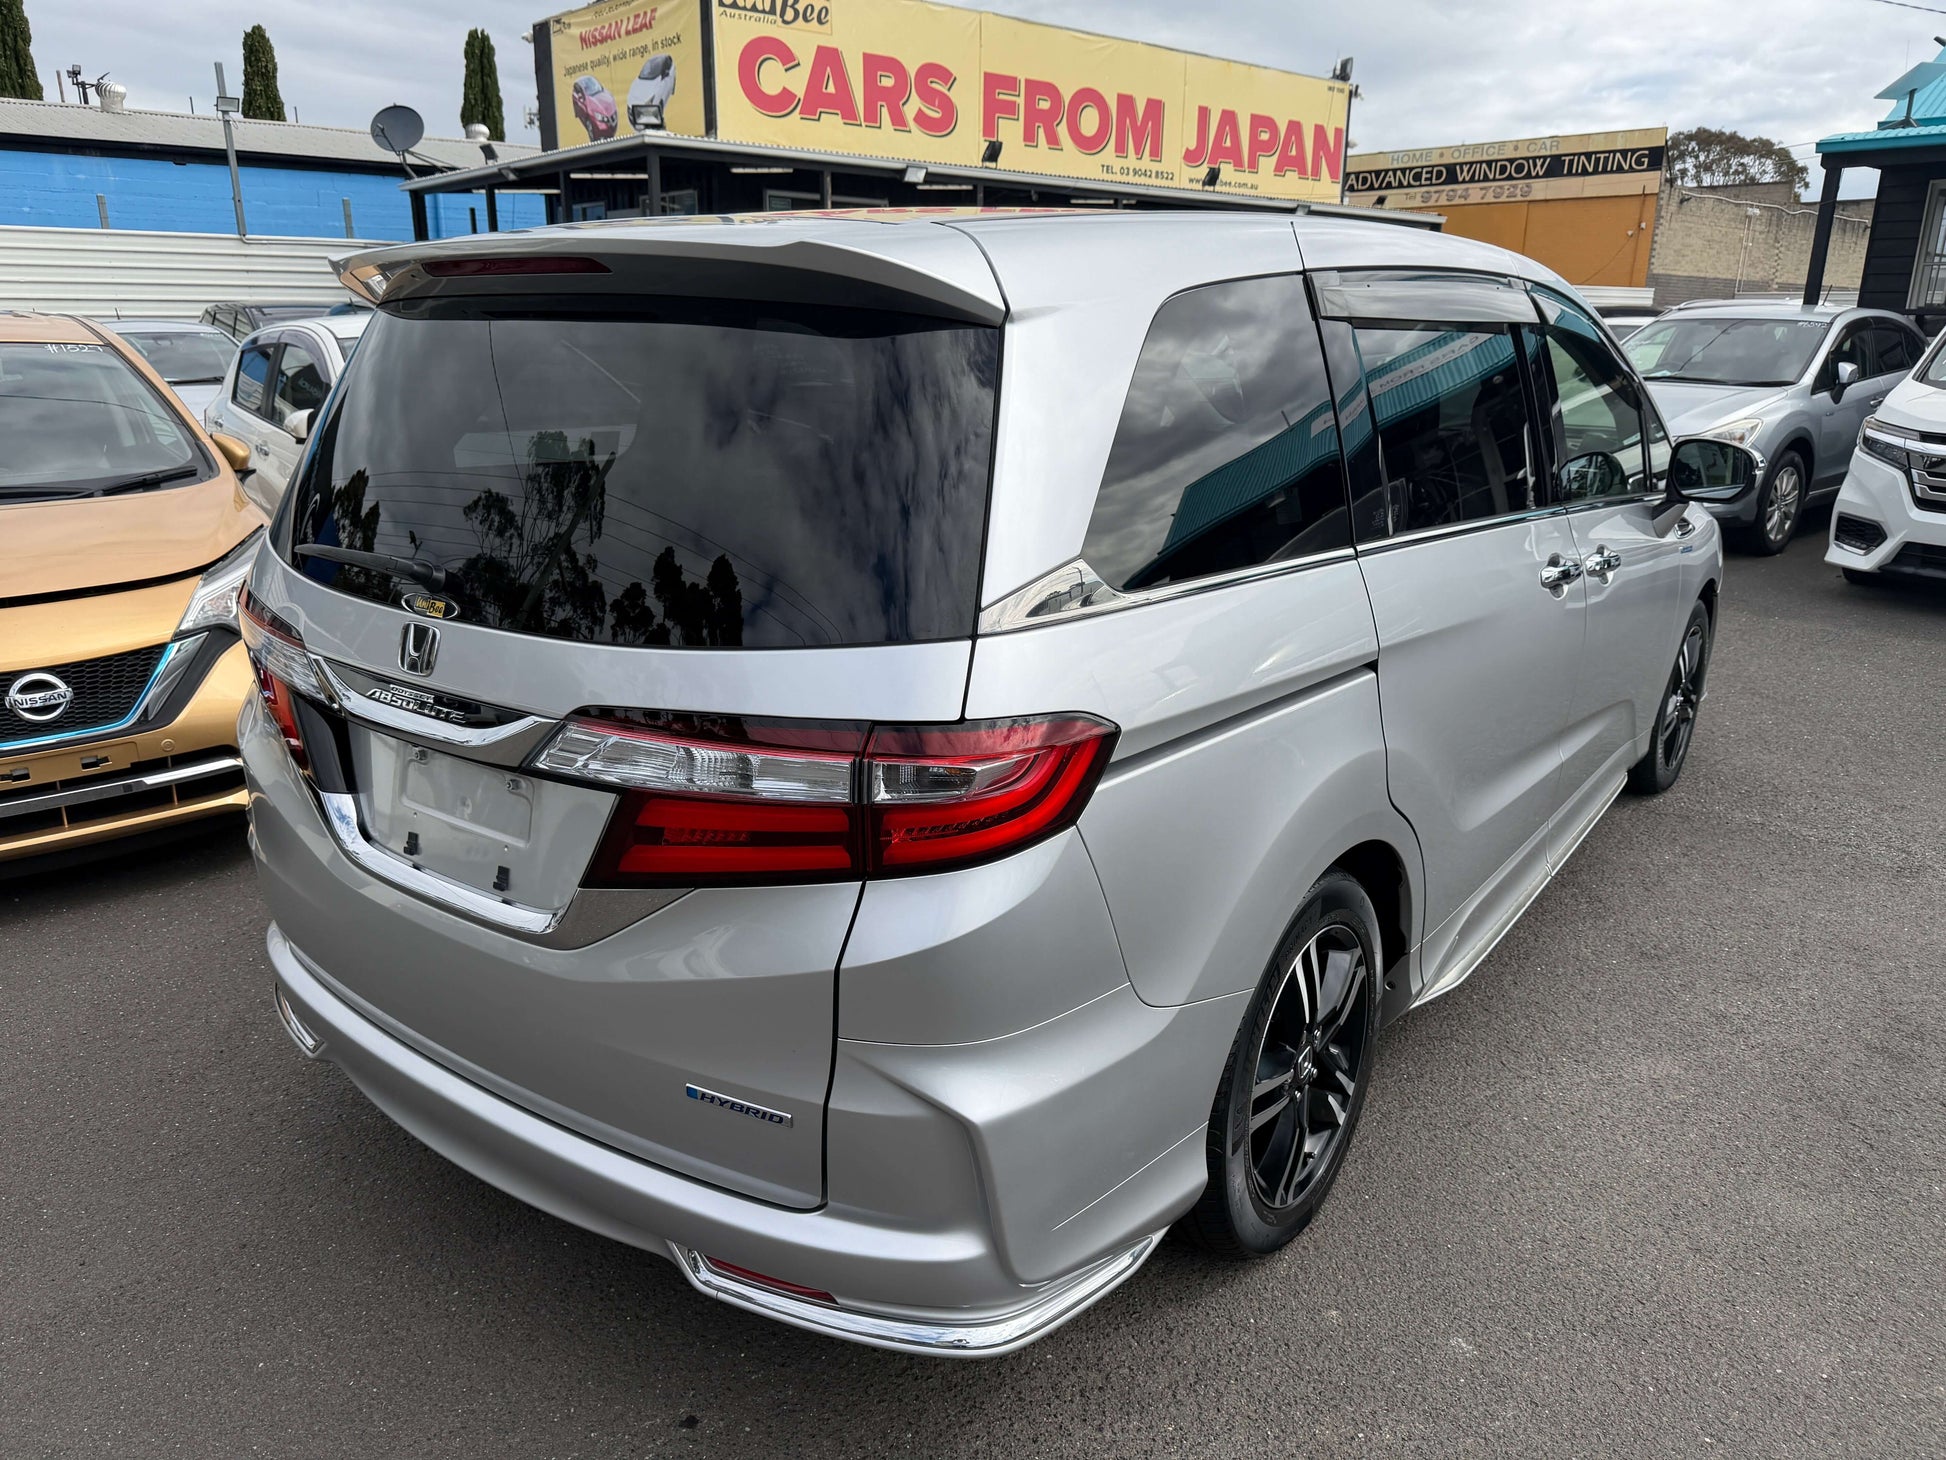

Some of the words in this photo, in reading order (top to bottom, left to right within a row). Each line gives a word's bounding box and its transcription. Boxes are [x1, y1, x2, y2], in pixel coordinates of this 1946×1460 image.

[579, 19, 623, 50] NISSAN
[624, 7, 657, 35] LEAF
[719, 9, 777, 25] Australia
[563, 62, 588, 77] Japanese
[612, 47, 627, 61] wide
[628, 43, 651, 59] range,
[652, 38, 659, 50] in
[660, 32, 682, 50] stock
[737, 36, 958, 138] CARS
[982, 71, 1165, 162] FROM
[1182, 105, 1344, 183] JAPAN
[1390, 151, 1433, 165] HOME
[1451, 143, 1507, 160] OFFICE
[1526, 139, 1561, 154] CAR
[1101, 164, 1117, 175] TEL.
[1119, 166, 1130, 177] 03
[1132, 169, 1153, 179] 9042
[1154, 171, 1175, 181] 8522
[1345, 166, 1447, 190] ADVANCED
[1456, 157, 1551, 182] WINDOW
[1561, 150, 1649, 175] TINTING
[1404, 191, 1417, 201] Tel
[1420, 188, 1470, 204] 9794
[1479, 183, 1533, 200] 7929
[13, 690, 68, 707] NISSAN
[365, 688, 466, 724] ABSOLUTE
[700, 1092, 784, 1124] HYBRID
